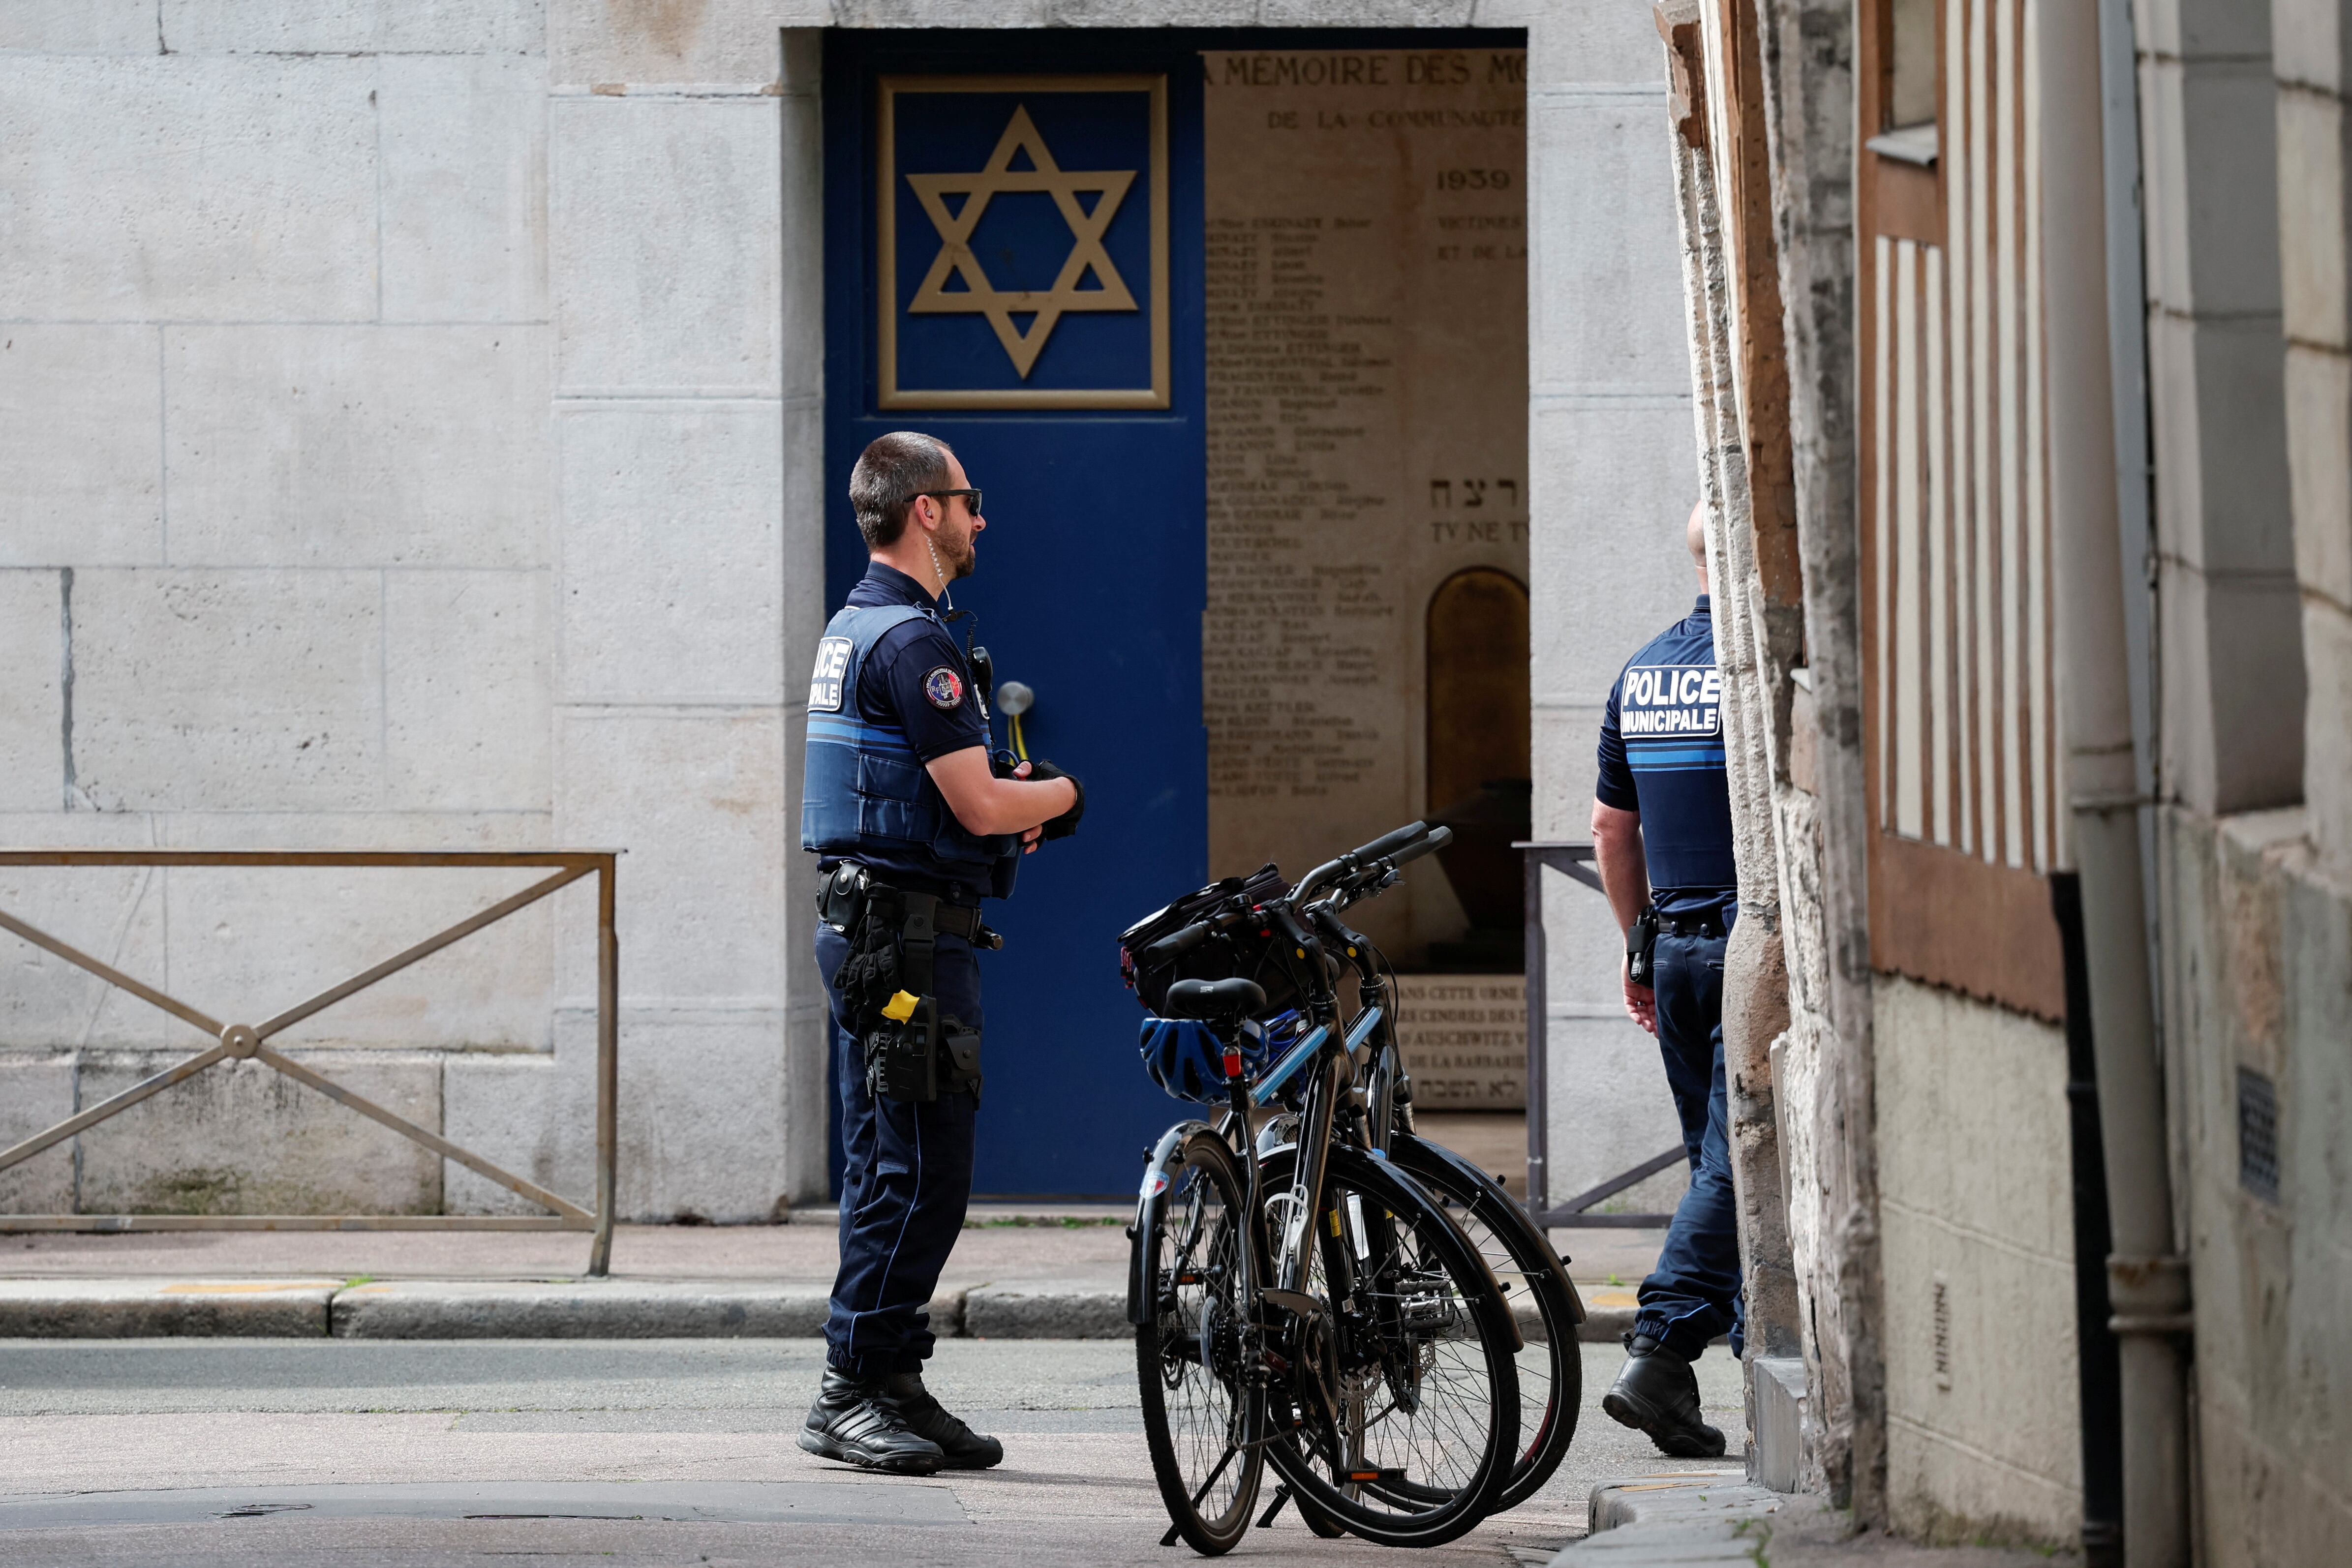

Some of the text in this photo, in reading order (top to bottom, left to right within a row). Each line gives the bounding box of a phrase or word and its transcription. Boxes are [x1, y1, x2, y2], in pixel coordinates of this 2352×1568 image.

[1406, 54, 1470, 85] DES
[1267, 111, 1299, 129] DE
[1317, 111, 1348, 129] LA
[1436, 169, 1511, 191] 1939
[1437, 245, 1460, 261] ET
[1623, 670, 1721, 706] POLICE
[1622, 708, 1717, 733] MUNICIPALE
